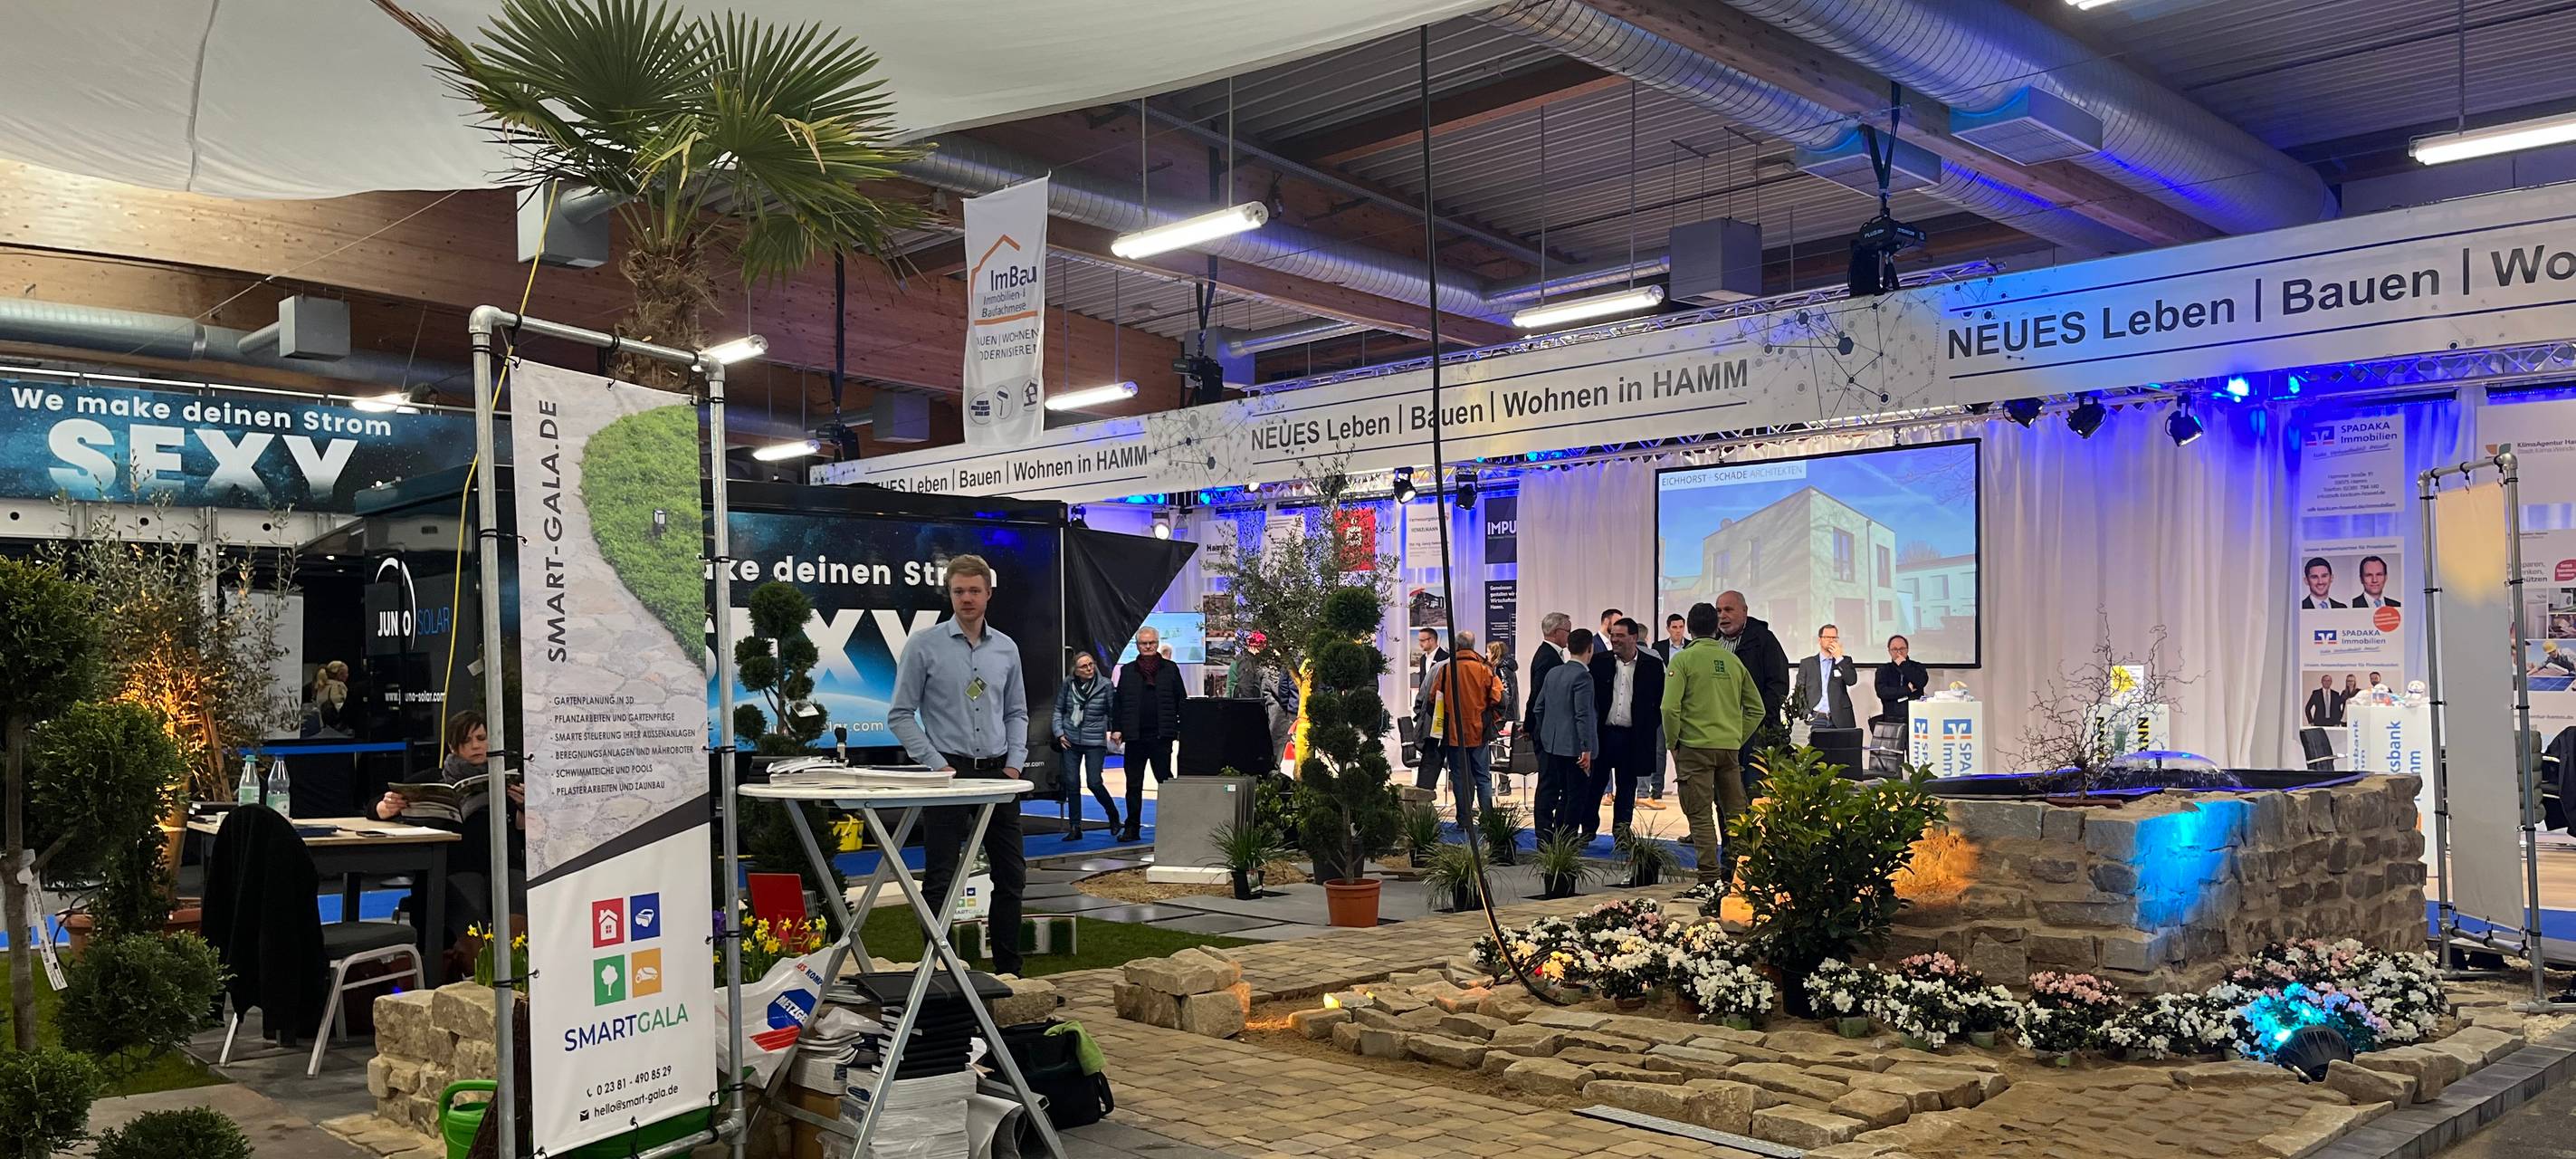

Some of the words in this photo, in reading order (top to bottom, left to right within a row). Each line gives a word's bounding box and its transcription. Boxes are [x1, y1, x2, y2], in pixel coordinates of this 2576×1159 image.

[990, 265, 1036, 291] ImBau
[1949, 311, 2086, 359] NEUES
[2103, 297, 2234, 340] Leben
[2282, 267, 2439, 316] Bauen
[10, 387, 63, 412] We
[77, 396, 171, 420] make
[182, 401, 291, 429] deinen
[303, 410, 392, 436] Strom
[1252, 420, 1320, 451] NEUES
[1327, 410, 1390, 440] Leben
[1411, 400, 1484, 431] Bauen
[1503, 384, 1608, 417] Wohnen
[1618, 376, 1642, 402] in
[1653, 359, 1748, 399] HAMM
[2341, 422, 2390, 434] SPADAKA
[2341, 433, 2398, 444] Immobilien
[48, 417, 359, 494] SEXY
[911, 475, 948, 493] Leben
[959, 468, 1001, 487] Bauen
[1014, 457, 1073, 482] Wohnen
[1078, 455, 1092, 474] in
[1096, 445, 1149, 471] HAMM
[1662, 474, 1706, 486] EICHHORST
[1714, 470, 1748, 482] SCHADE
[1751, 465, 1802, 479] ARCHITEKTEN
[539, 399, 567, 663] SMART-GALA.DE
[1487, 520, 1516, 535] IMPU
[773, 555, 892, 585] deinen
[417, 607, 451, 634] SOLAR
[554, 696, 615, 705] GARTENPLANUNG
[615, 696, 624, 704] IN
[625, 696, 634, 704] 3D
[555, 714, 611, 723] PFLANZARBEITEN
[613, 714, 626, 722] UND
[628, 713, 675, 722] GARTENPFLEGE
[555, 732, 582, 742] SMARTE
[584, 731, 621, 741] STEUERUNG
[624, 730, 641, 739] IHRER
[643, 729, 695, 738] AUSSENANLAGEN
[556, 748, 634, 760] BEREGNUNGSANLAGEN
[636, 747, 650, 756] UND
[652, 745, 694, 755] MÄHROBOTER
[556, 767, 614, 778] SCHWIMMTEICHE
[615, 765, 630, 774] UND
[632, 764, 653, 773] POOLS
[557, 783, 618, 796] PFLASTERARBEITEN
[619, 782, 634, 791] UND
[634, 781, 665, 790] ZAUNBAU
[565, 1003, 689, 1051] SMARTGALA
[596, 1085, 602, 1096] 0
[605, 1081, 615, 1094] 23
[616, 1078, 626, 1091] 81
[634, 1071, 649, 1085] 490
[651, 1068, 661, 1080] 85
[662, 1065, 672, 1077] 29
[594, 1084, 679, 1117] hello@smart-gala.de
